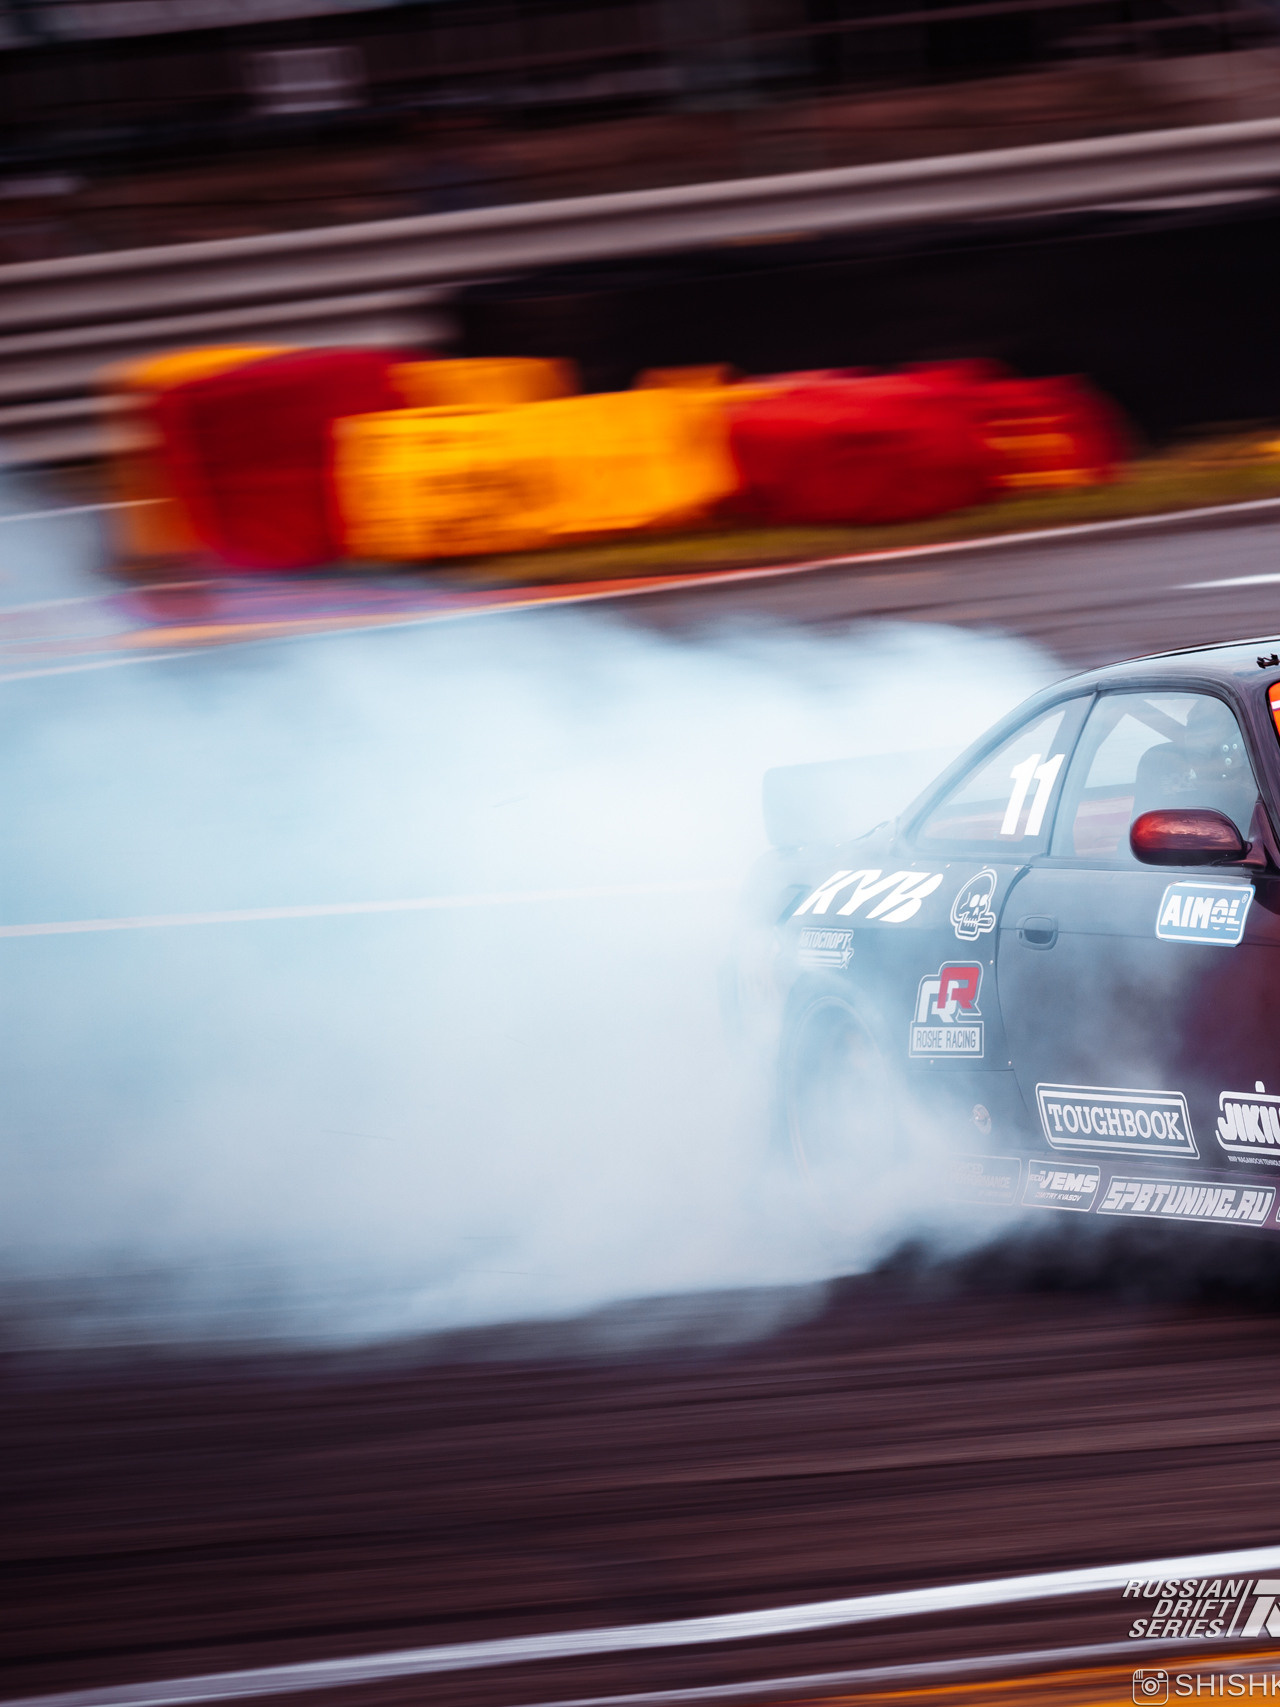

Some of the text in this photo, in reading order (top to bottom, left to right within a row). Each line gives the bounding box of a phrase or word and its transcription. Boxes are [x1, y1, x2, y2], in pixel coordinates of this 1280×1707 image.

[1000, 753, 1066, 836] 11
[792, 869, 944, 923] KYB
[1160, 894, 1241, 931] AIMOL
[915, 1029, 977, 1049] ROSHE RACING
[1047, 1103, 1185, 1142] TOUGHBOOK
[1039, 1170, 1099, 1194] VEMS
[1100, 1181, 1273, 1222] SPBTUNING.RU
